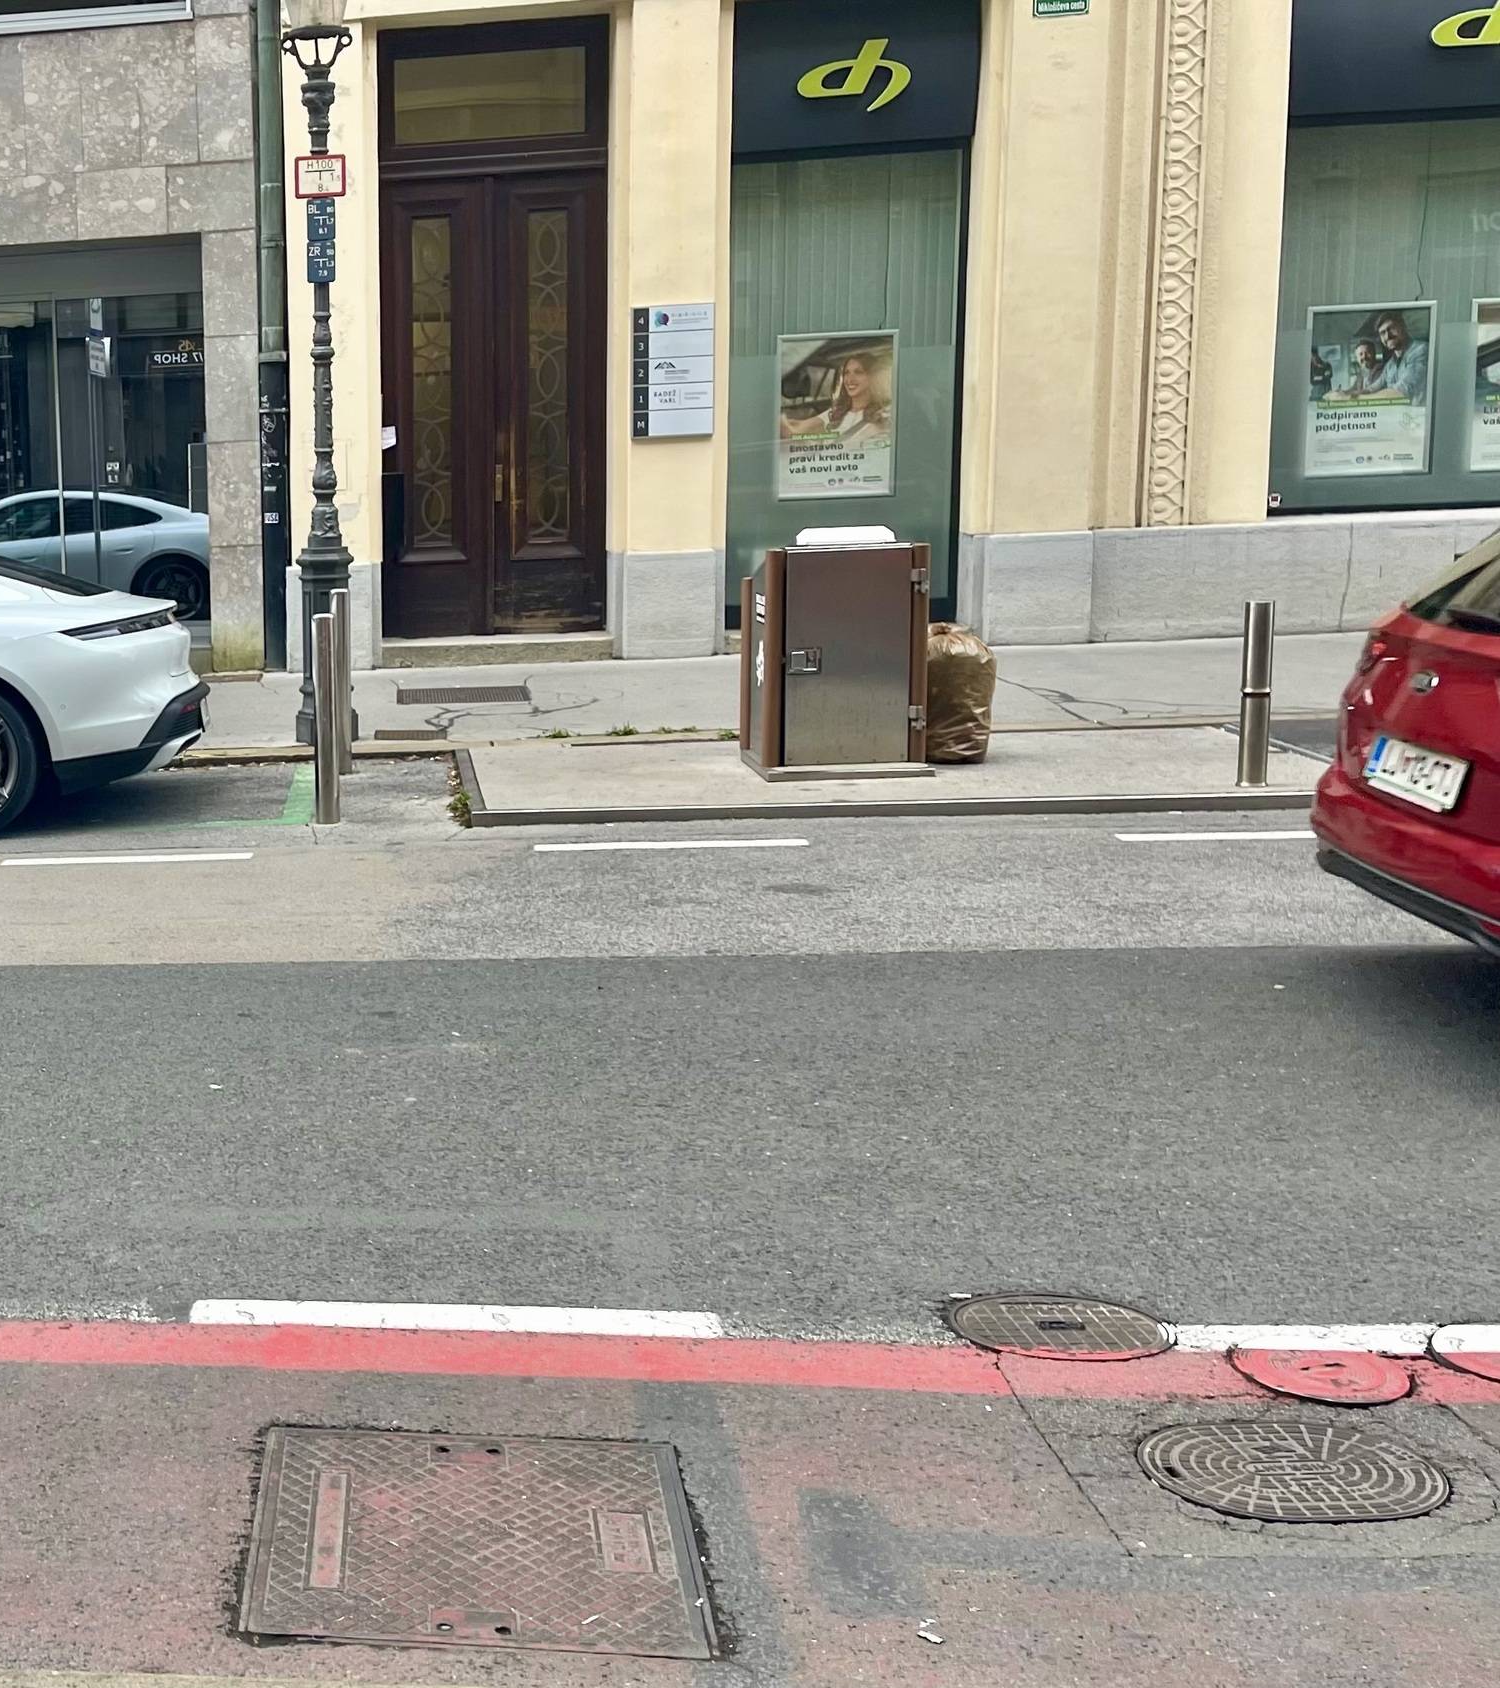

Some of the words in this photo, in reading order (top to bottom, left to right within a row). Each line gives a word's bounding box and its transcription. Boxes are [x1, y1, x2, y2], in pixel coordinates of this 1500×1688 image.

[638, 342, 645, 351] 3
[638, 369, 644, 377] 2
[639, 395, 644, 403] 1
[1316, 410, 1378, 422] Podpiramo
[637, 421, 645, 429] M
[1315, 421, 1377, 433] podjetnost
[789, 442, 844, 453] Enostavno
[789, 454, 816, 465] pravi
[818, 452, 850, 462] kredit
[852, 452, 865, 460] za
[789, 466, 807, 474] vaš
[809, 463, 832, 473] novi
[835, 463, 859, 472] avto
